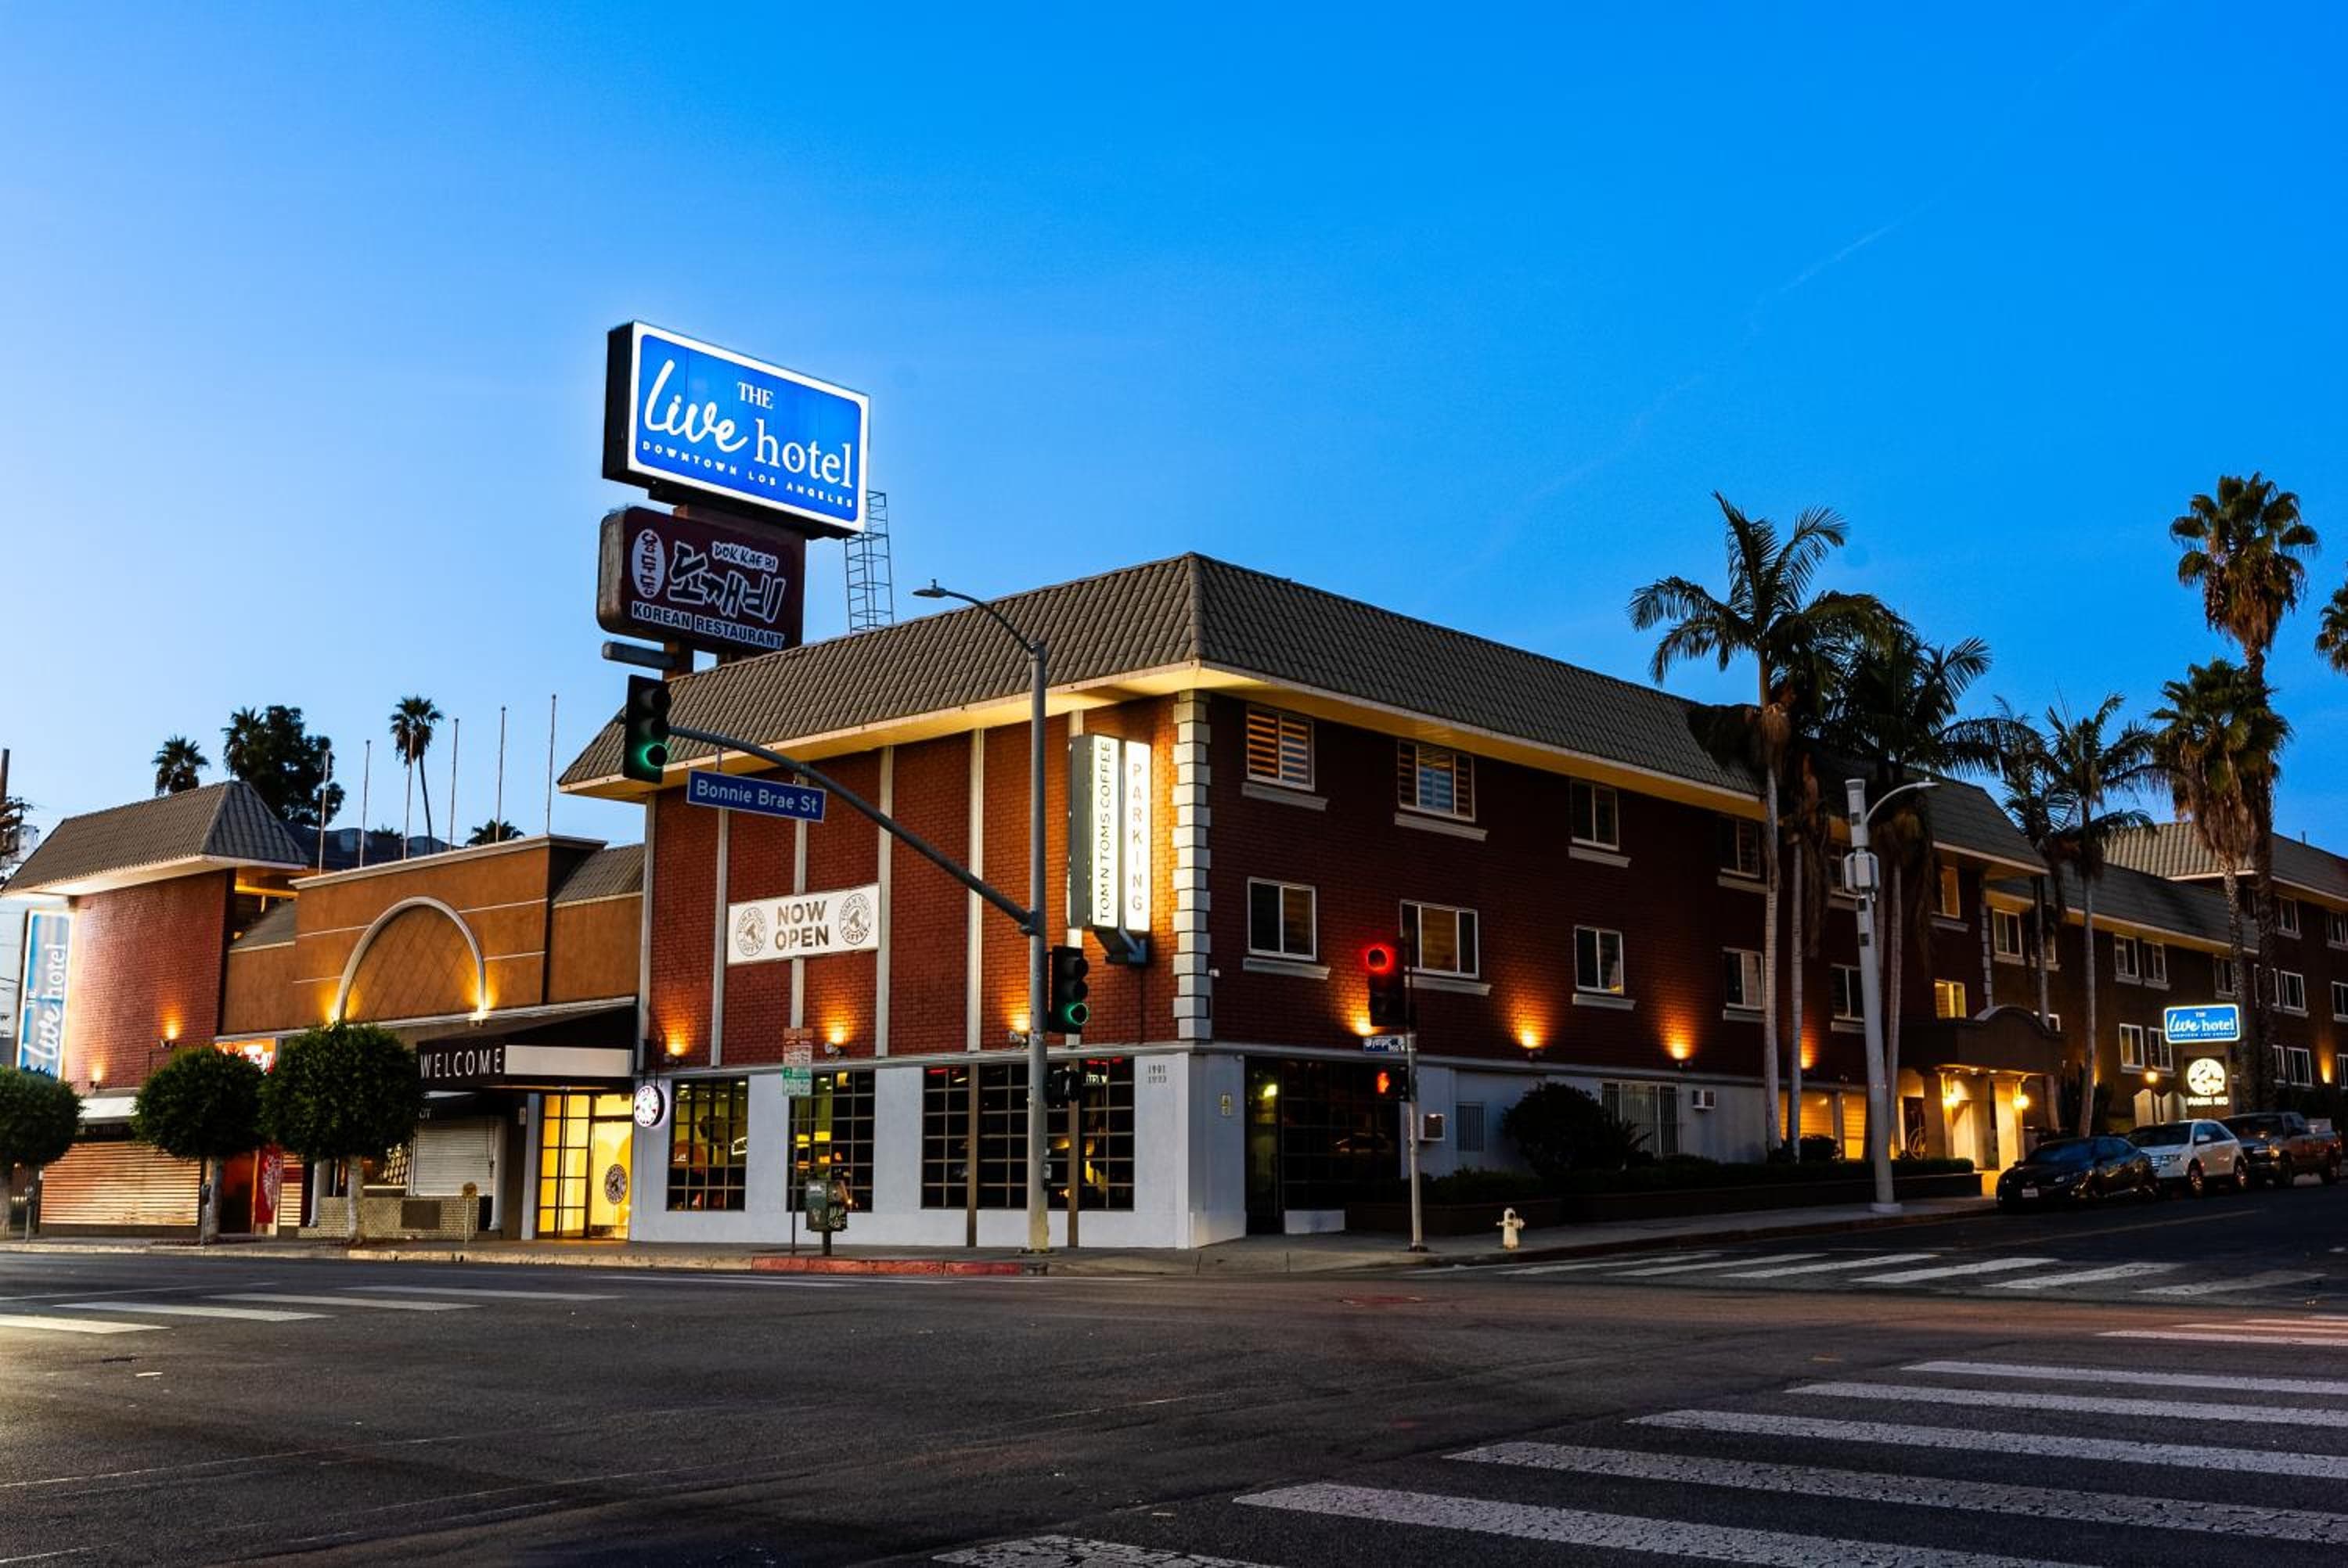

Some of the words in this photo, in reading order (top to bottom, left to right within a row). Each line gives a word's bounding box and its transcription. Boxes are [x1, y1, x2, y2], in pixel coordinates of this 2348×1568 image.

[737, 381, 774, 409] THE
[754, 419, 852, 488] hotel
[643, 441, 737, 476] DOWNTOWN
[748, 471, 776, 486] LOS
[786, 482, 852, 508] ANGELES
[632, 601, 692, 630] KOREAN
[694, 615, 784, 650] RESTAURANT
[1100, 741, 1111, 808] COFFEE
[696, 779, 752, 803] Bonnie
[758, 789, 795, 810] Brae
[801, 795, 818, 813] St
[1133, 763, 1143, 912] PARKING
[776, 900, 828, 926] NOW
[775, 925, 830, 951] OPEN
[45, 944, 66, 1000] hotel
[2202, 1017, 2235, 1031] hotel
[420, 1048, 502, 1078] WELCOME
